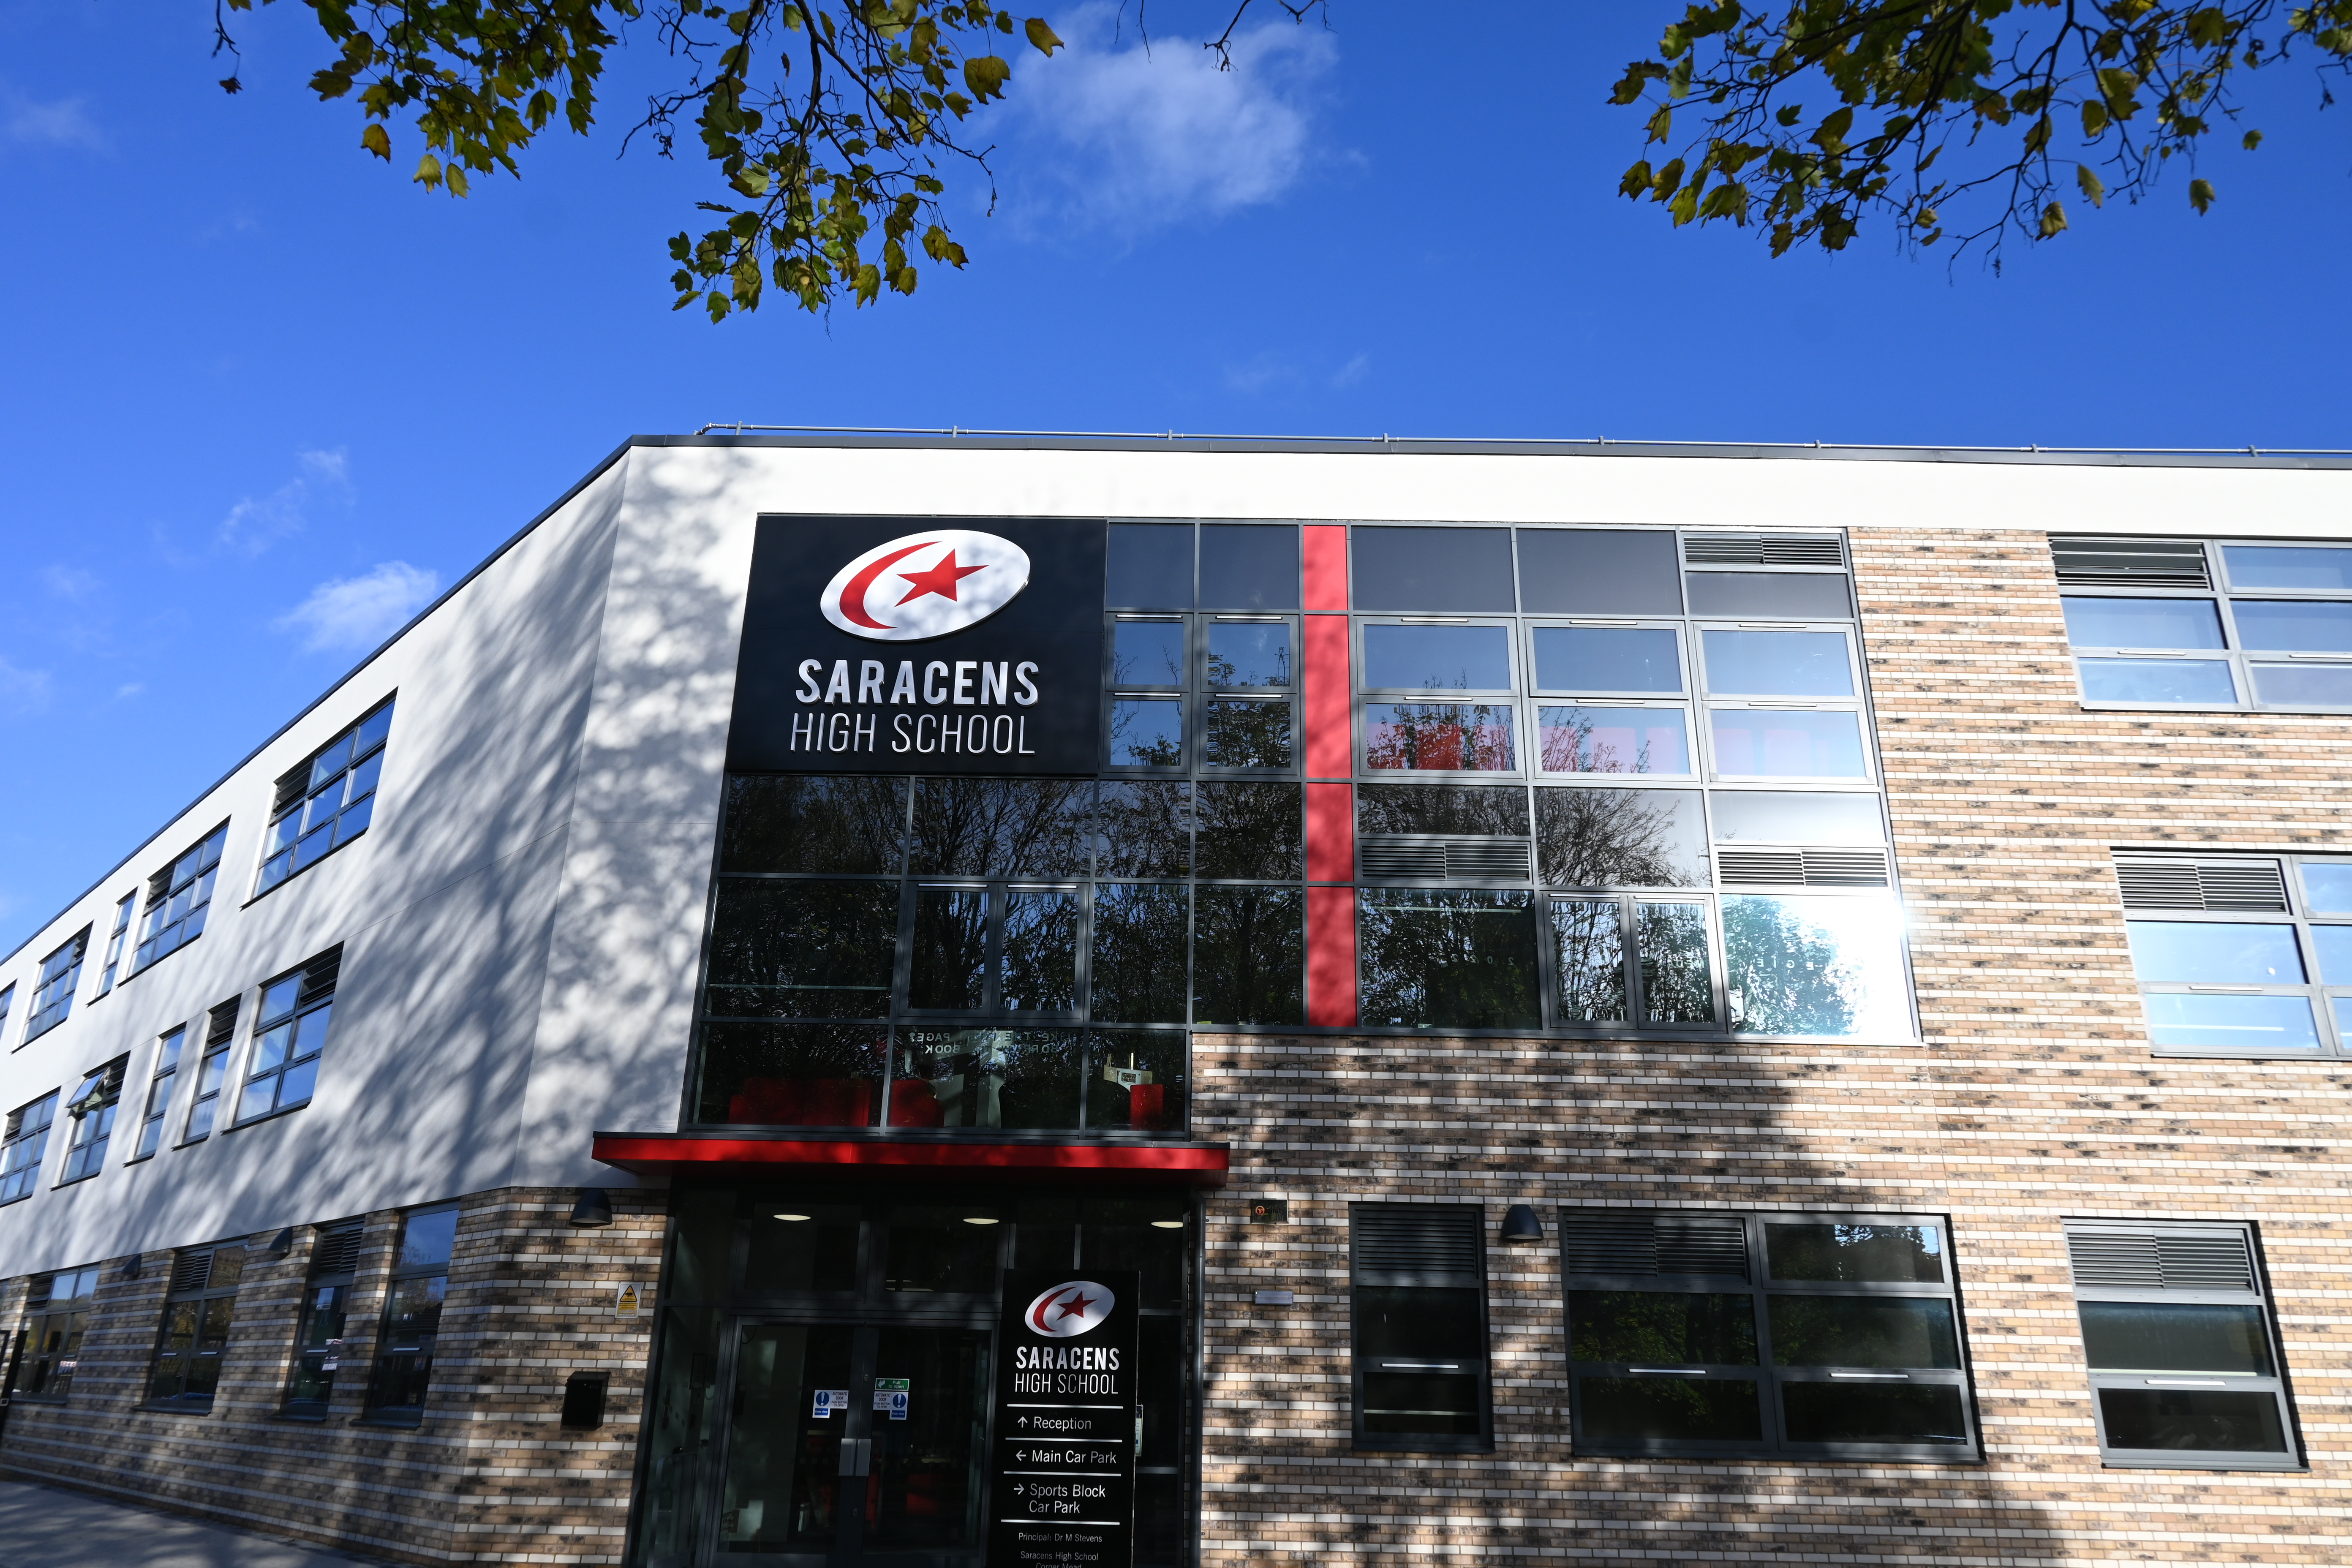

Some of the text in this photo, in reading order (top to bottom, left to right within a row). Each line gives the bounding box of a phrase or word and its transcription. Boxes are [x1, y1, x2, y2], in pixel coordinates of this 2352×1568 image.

[795, 659, 1039, 707] SARACENS
[790, 712, 1036, 755] HIGH SCHOOL
[1016, 1346, 1119, 1370] SARACENS
[1015, 1373, 1119, 1394] HIGH SCHOOL
[1034, 1416, 1091, 1432] Reception
[1032, 1450, 1116, 1464] Main Car Park
[1030, 1483, 1105, 1499] Sports Block
[1029, 1500, 1080, 1514] Car Park
[1018, 1532, 1102, 1542] Principal: Dr M Stevens
[1021, 1551, 1098, 1562] Saracens High School
